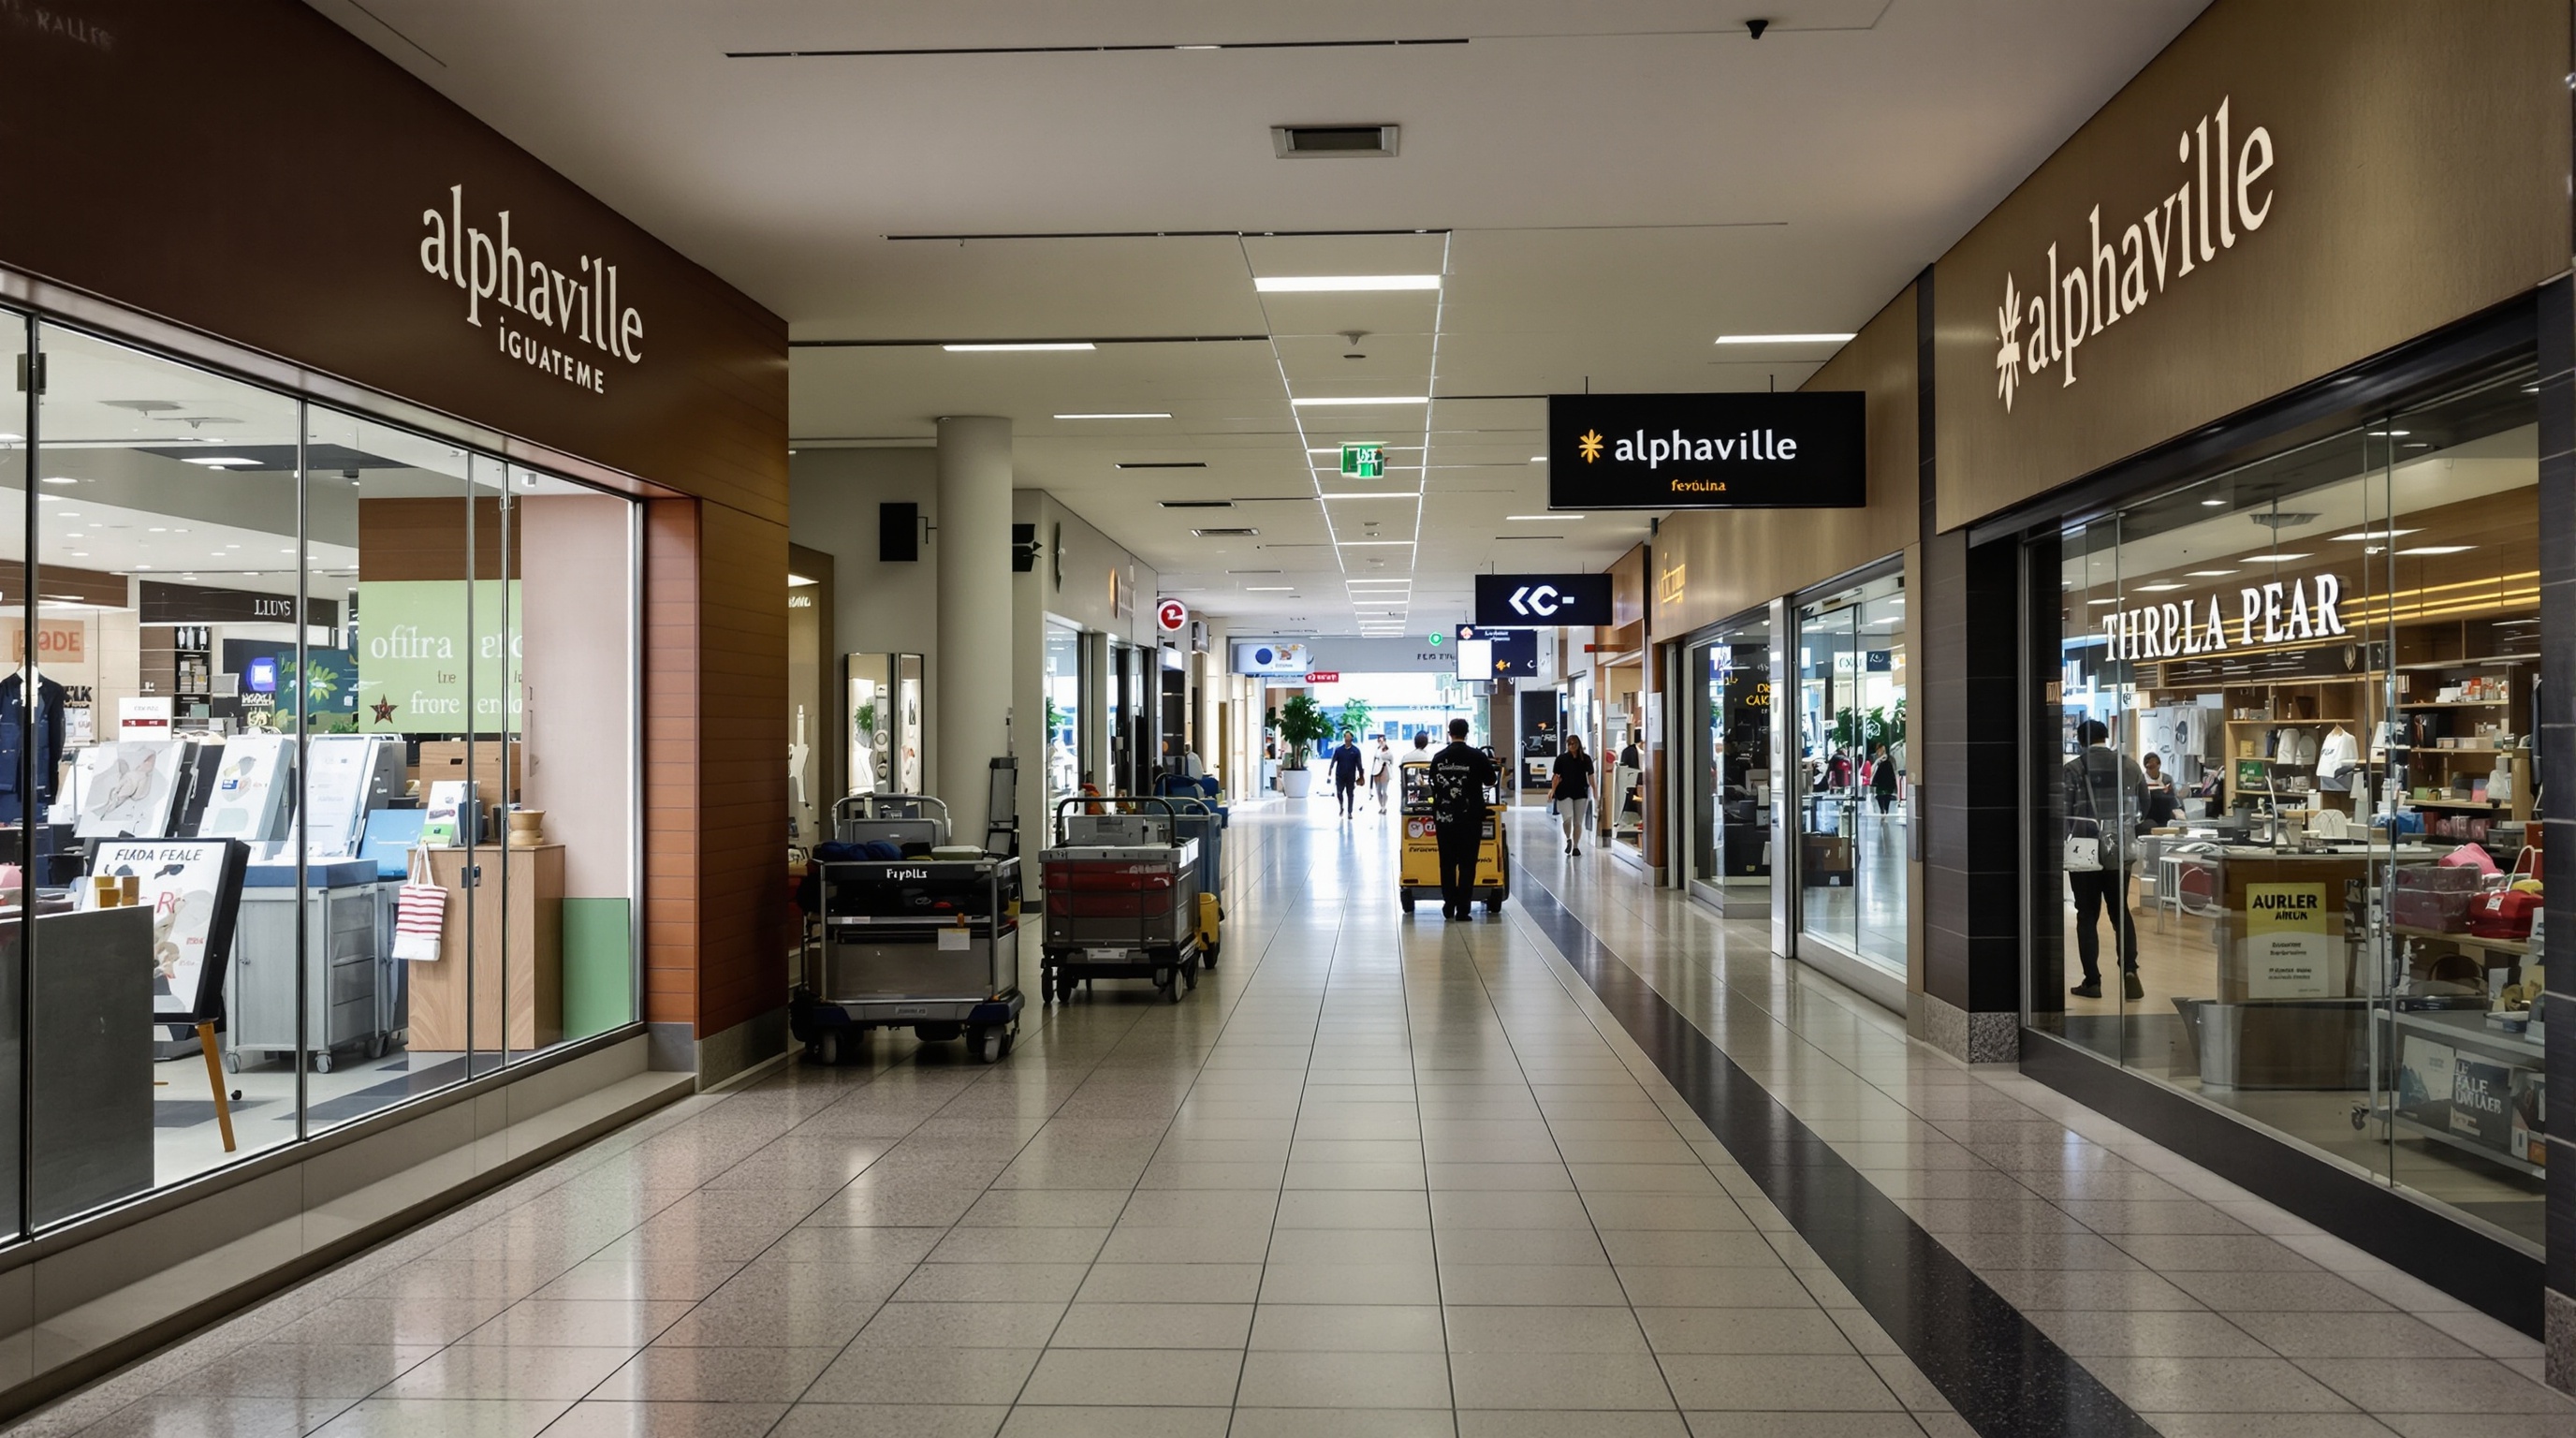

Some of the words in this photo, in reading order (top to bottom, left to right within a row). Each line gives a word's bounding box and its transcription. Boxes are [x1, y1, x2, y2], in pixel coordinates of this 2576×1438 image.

[420, 183, 644, 364] alphaville
[2027, 94, 2275, 389] alphaville
[1614, 428, 1797, 469] alphaville
[2240, 573, 2346, 646] PEAR
[2251, 893, 2319, 909] AURLER
